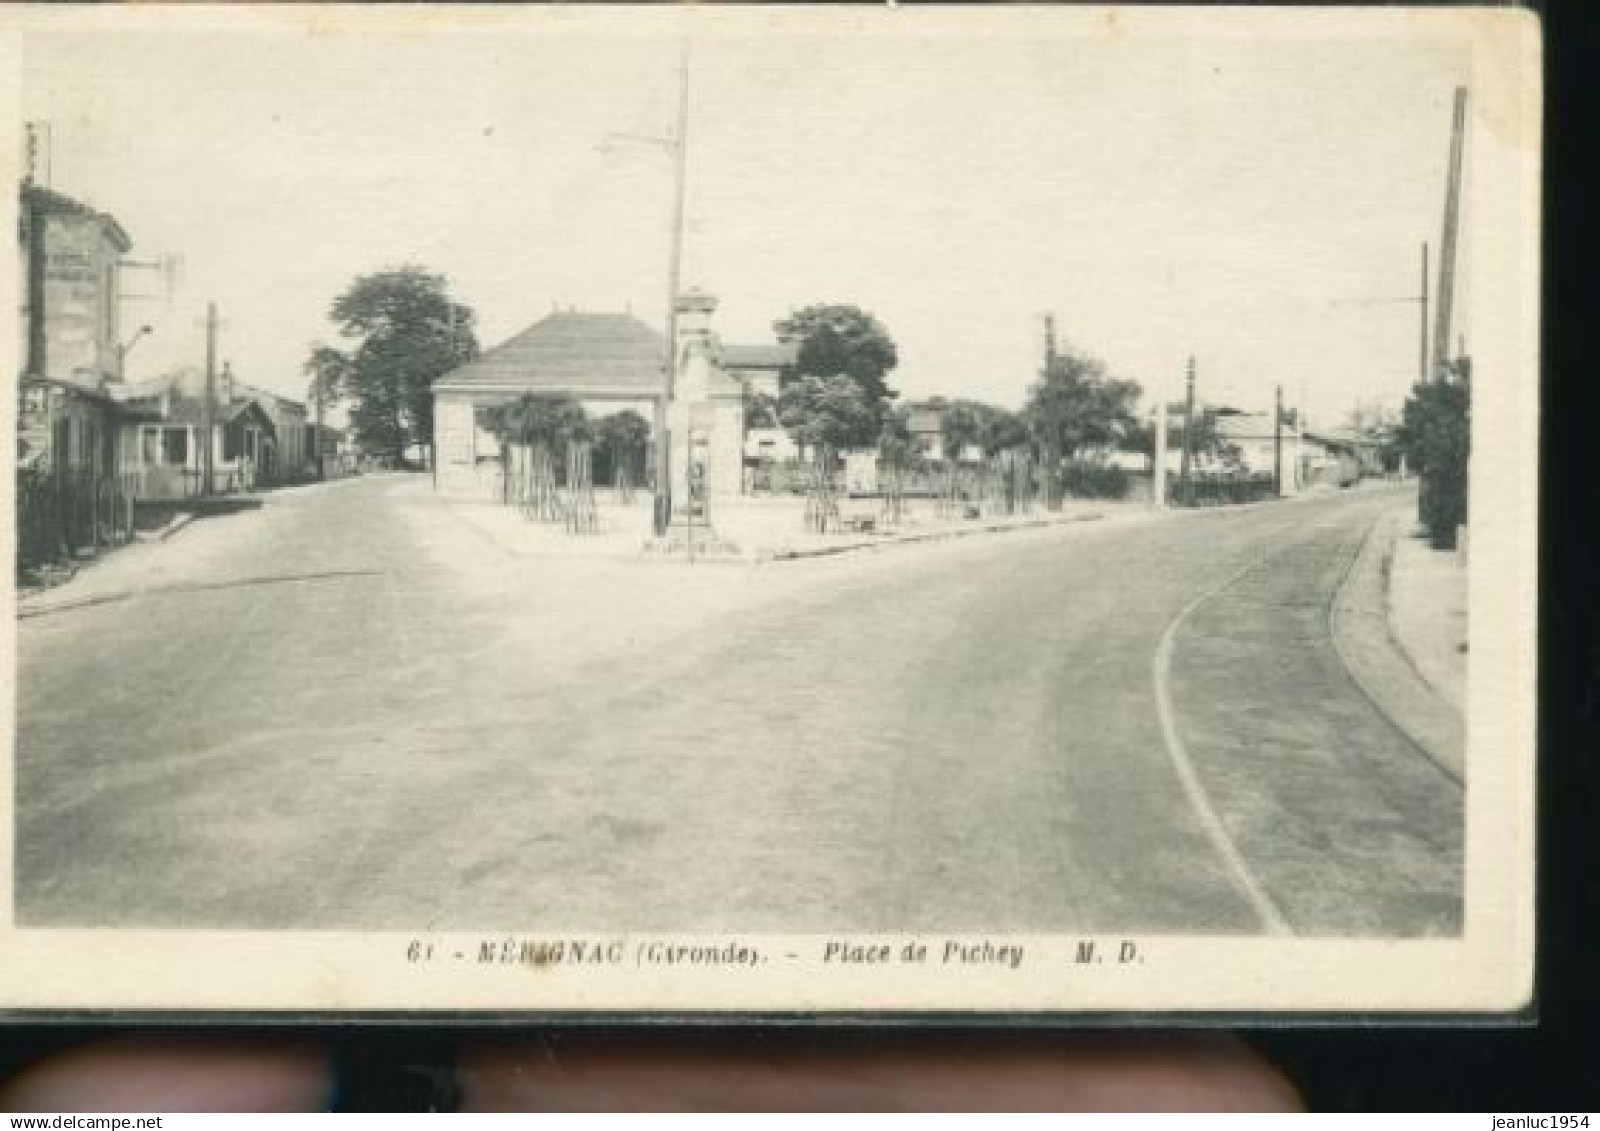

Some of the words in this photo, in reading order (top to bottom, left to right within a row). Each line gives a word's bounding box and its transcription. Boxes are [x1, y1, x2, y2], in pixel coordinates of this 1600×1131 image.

[823, 941, 890, 964] Place
[900, 941, 927, 963] de
[942, 940, 1024, 969] Pichey
[1075, 940, 1103, 964] M.
[1118, 940, 1144, 964] D.
